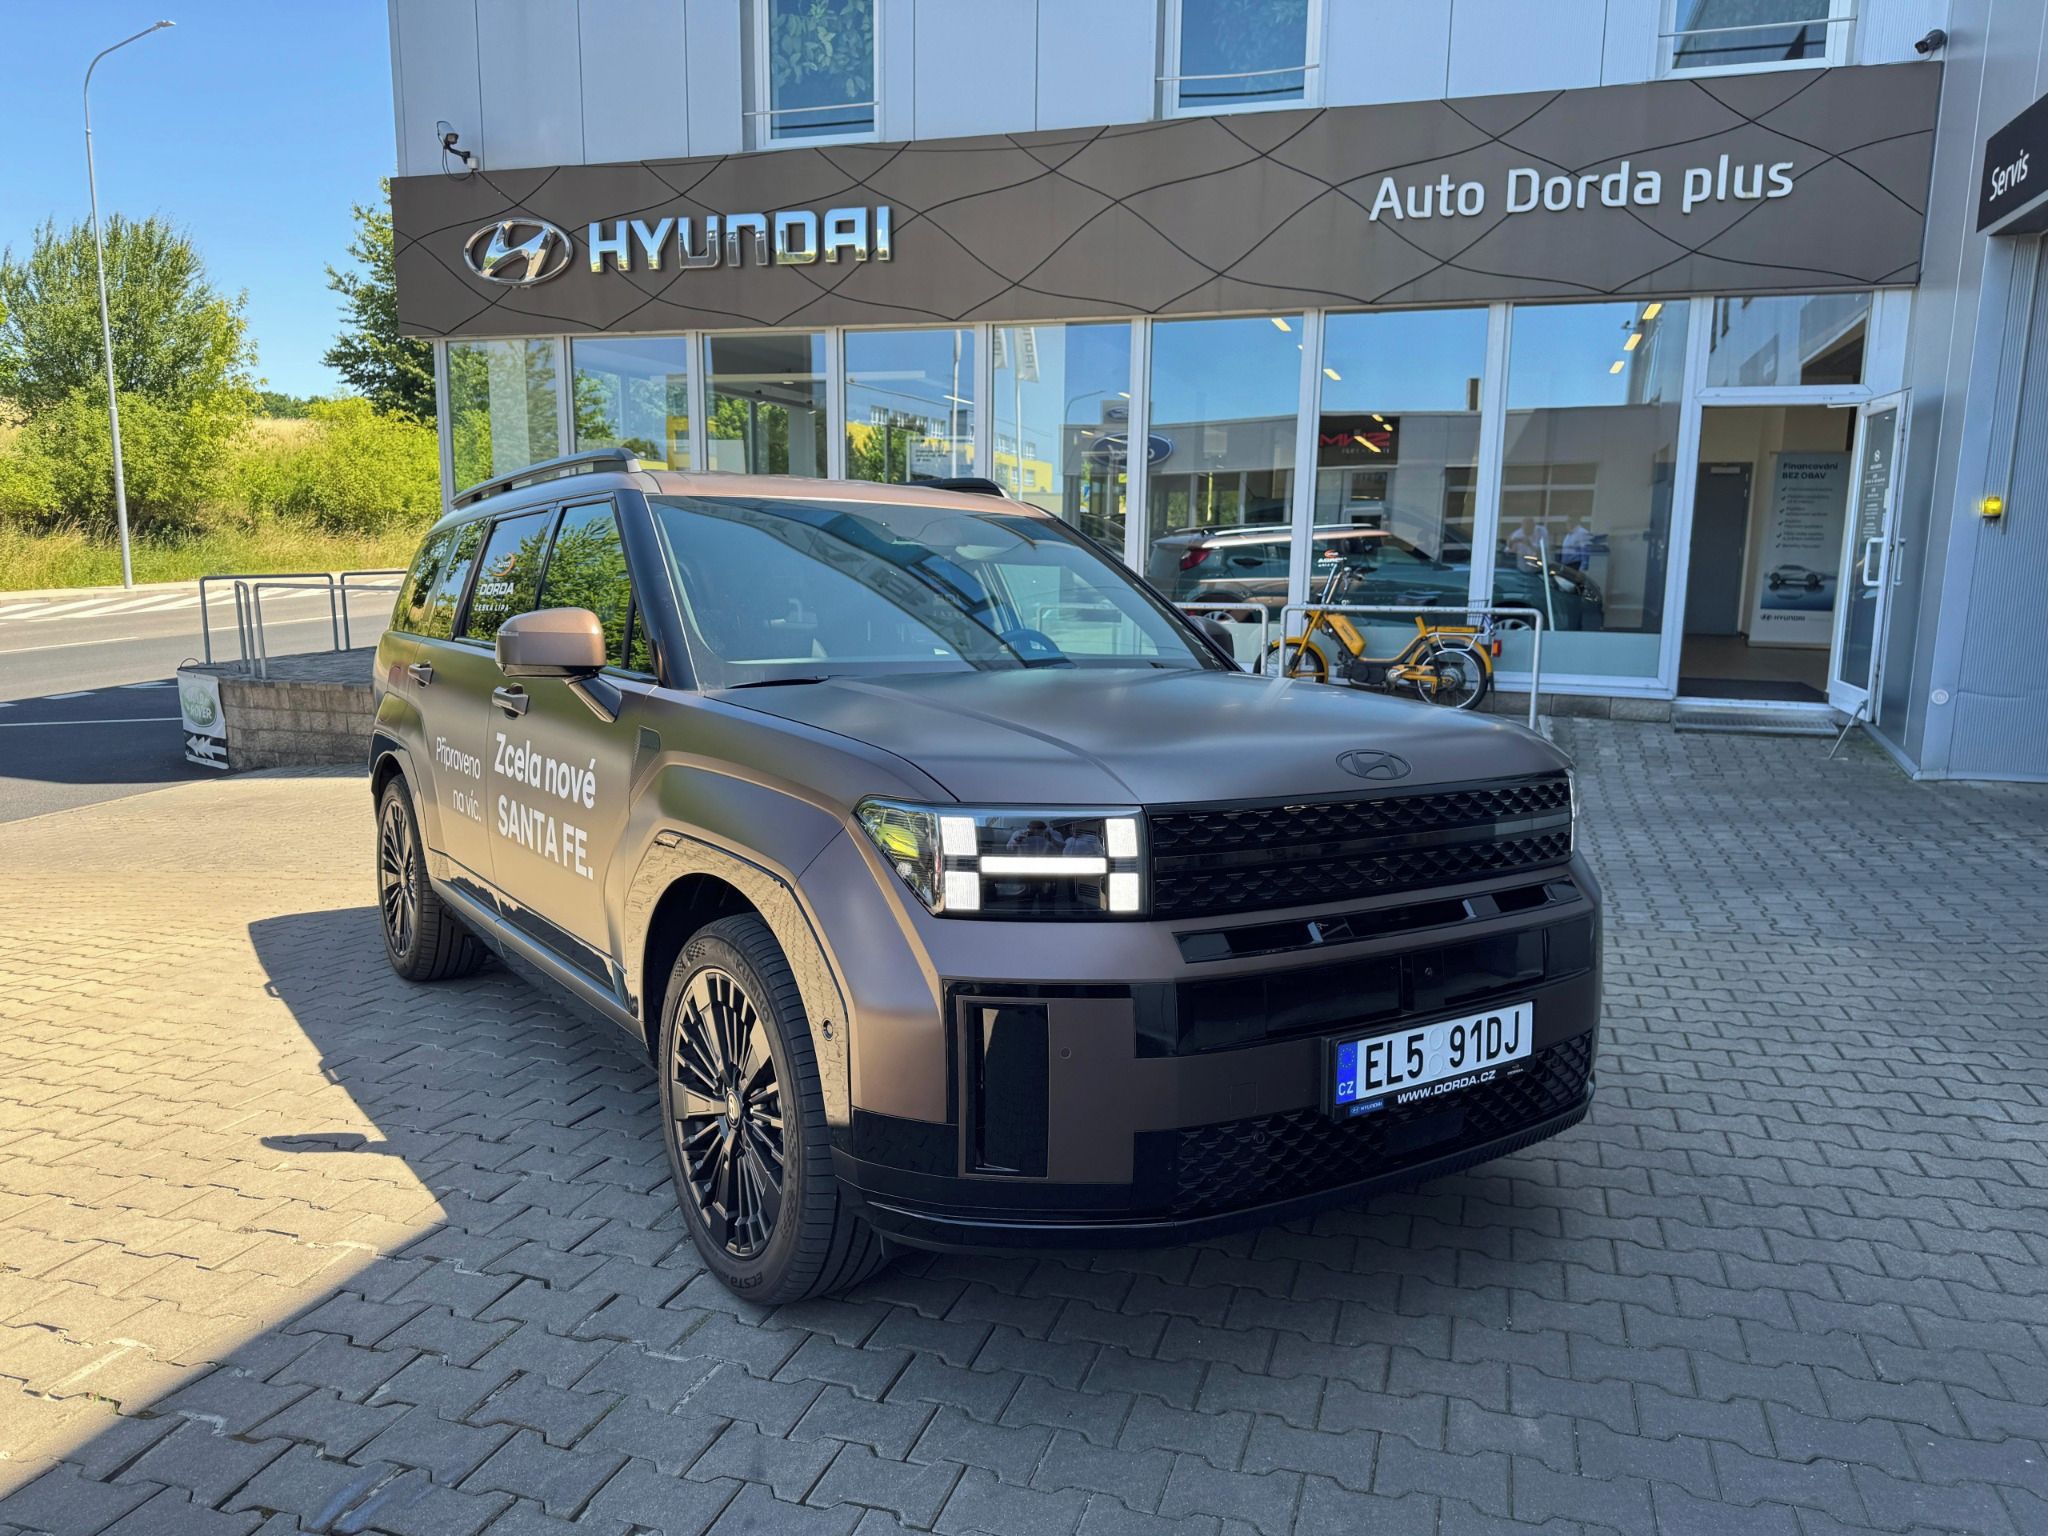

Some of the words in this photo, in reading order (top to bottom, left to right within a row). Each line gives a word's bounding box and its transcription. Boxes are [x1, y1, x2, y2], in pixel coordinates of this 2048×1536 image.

[1368, 173, 1486, 221] Auto
[1506, 160, 1662, 213] Dorda
[1682, 154, 1794, 214] plus
[1988, 148, 2030, 202] Servis
[588, 205, 892, 273] HYUNDAI
[1782, 461, 1839, 471] Financování
[1782, 471, 1800, 480] BEZ
[1801, 471, 1828, 480] OBAV
[479, 582, 515, 596] DORDA
[436, 735, 481, 780] Připraveno
[494, 732, 542, 789] Zcela
[545, 757, 597, 809] nové
[453, 789, 465, 813] na
[465, 789, 481, 823] víc.
[498, 794, 559, 864] SANTA
[562, 821, 594, 881] FE.
[1364, 1032, 1426, 1091] EL5
[1449, 1010, 1520, 1069] 91DJ
[1338, 1080, 1354, 1096] CZ
[1397, 1069, 1497, 1105] WWW.DORDA.CZ
